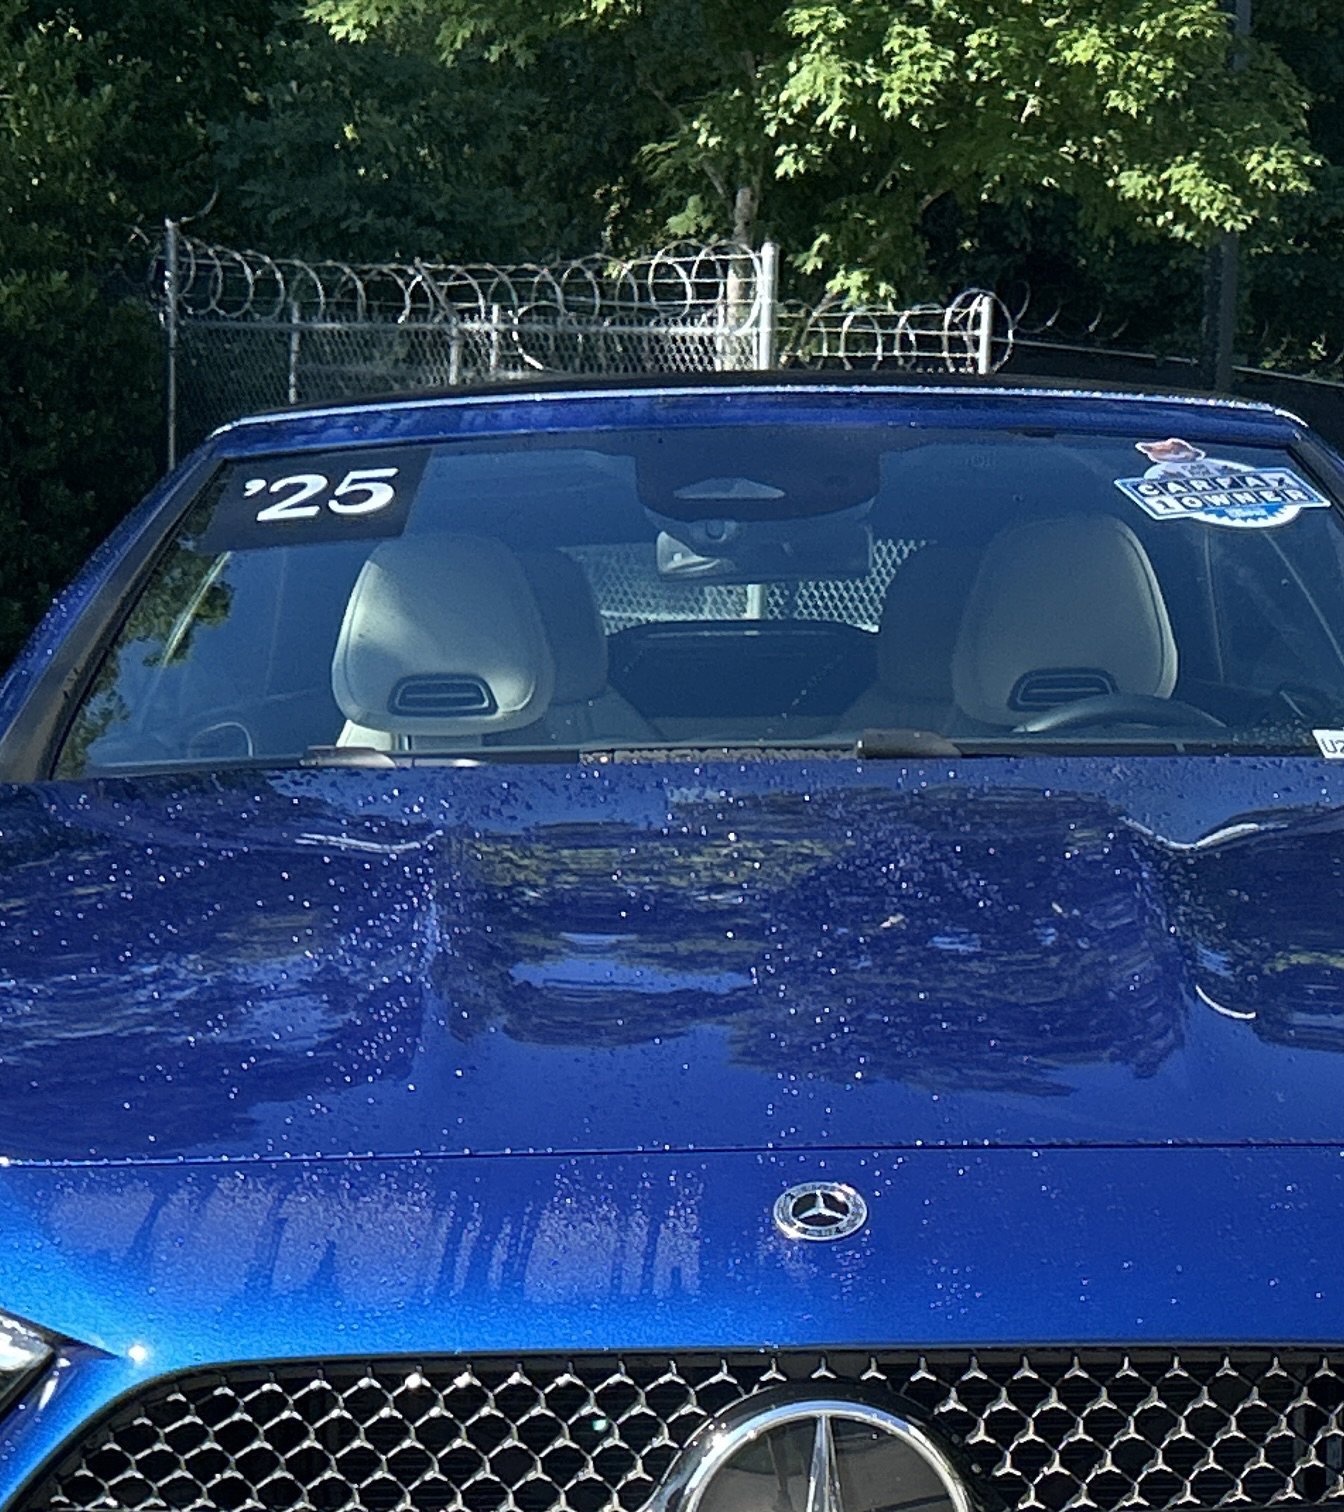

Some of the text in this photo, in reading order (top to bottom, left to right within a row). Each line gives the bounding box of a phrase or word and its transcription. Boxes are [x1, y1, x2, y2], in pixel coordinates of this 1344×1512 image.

[243, 467, 400, 521] '25
[1137, 474, 1297, 496] CARFAX
[1181, 489, 1308, 508] OWNER
